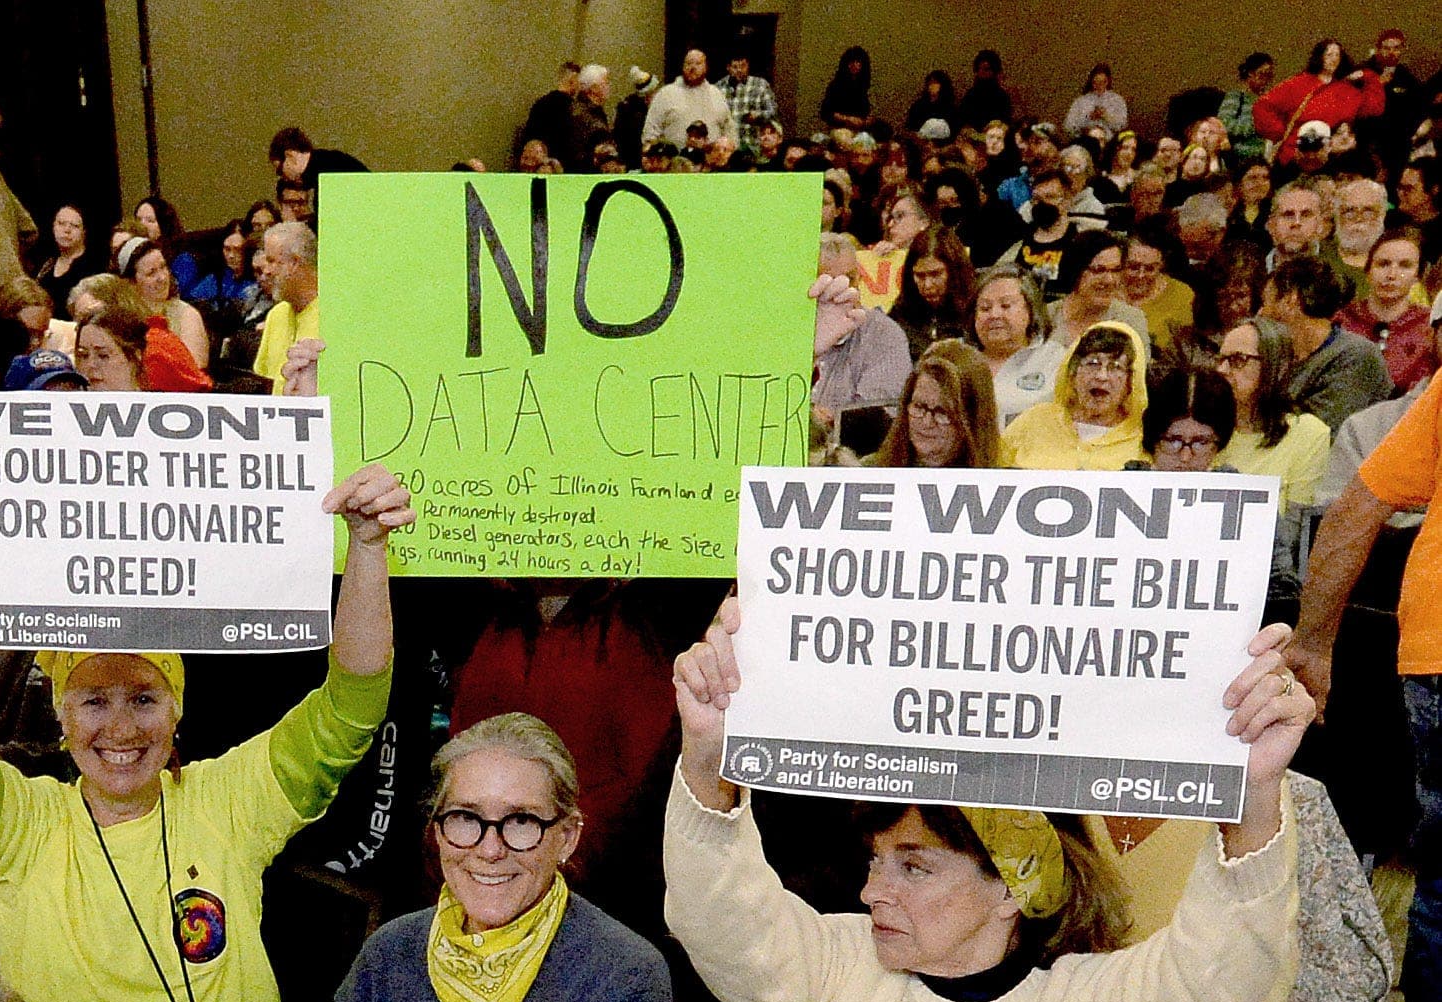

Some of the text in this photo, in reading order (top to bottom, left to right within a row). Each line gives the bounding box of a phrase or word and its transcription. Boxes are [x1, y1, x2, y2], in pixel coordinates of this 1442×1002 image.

[465, 177, 685, 358] NO
[858, 261, 905, 294] N
[69, 402, 324, 442] WON'T
[359, 360, 808, 467] DATA CENTER
[160, 451, 229, 489] THE
[240, 454, 316, 491] BILL
[433, 479, 493, 496] acres
[549, 473, 619, 498] Illinois
[631, 477, 713, 500] Farmland
[60, 500, 285, 545] BILLIONAIRE
[748, 481, 1269, 541] WE WON'T
[428, 522, 477, 542] Diesel
[583, 530, 629, 550] each
[638, 530, 672, 550] the
[66, 555, 197, 597] GREED!
[387, 541, 642, 574] igs, running 24 hours a day!
[766, 546, 1239, 612] SHOULDER THE BILL
[9, 630, 88, 645] Liberation
[19, 612, 41, 627] for
[45, 613, 121, 629] Socialism
[222, 623, 318, 642] @PSL.CIL
[789, 615, 1190, 680] FOR BILLIONAIRE
[893, 687, 1062, 741] GREED!
[775, 770, 914, 793] and Liberation
[778, 748, 828, 770] Party
[833, 751, 860, 768] for
[864, 753, 959, 775] Socialism
[1091, 766, 1223, 807] @PSL.CIL
